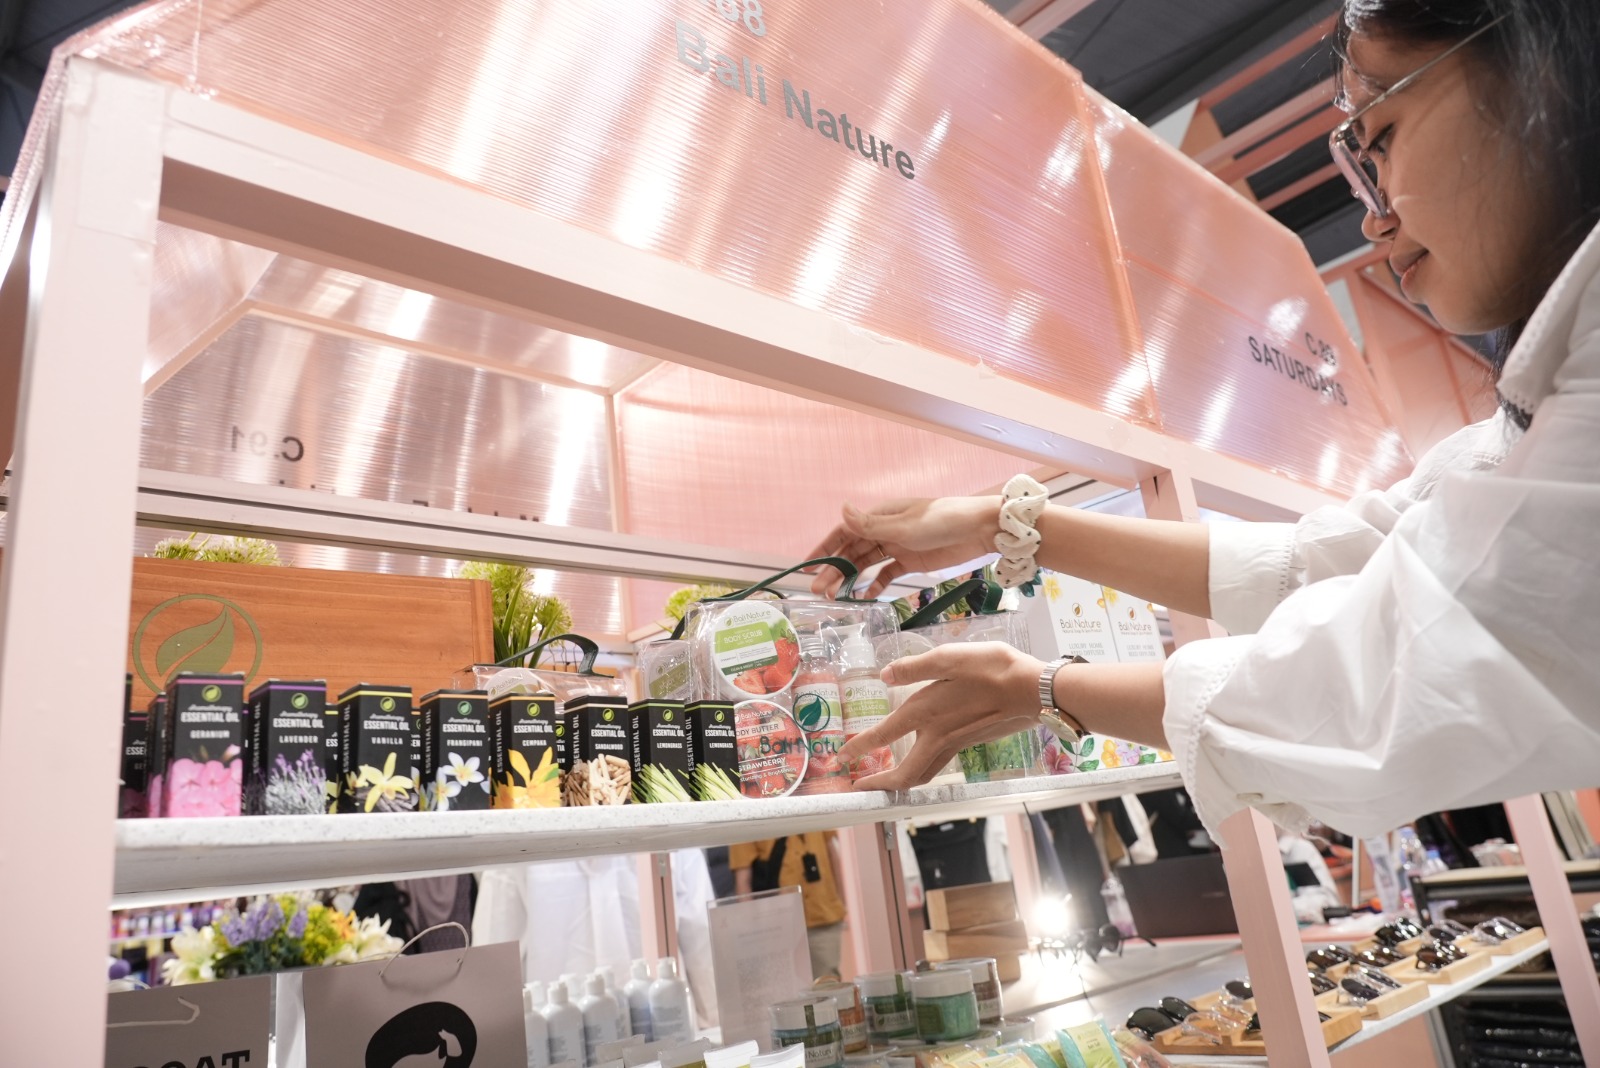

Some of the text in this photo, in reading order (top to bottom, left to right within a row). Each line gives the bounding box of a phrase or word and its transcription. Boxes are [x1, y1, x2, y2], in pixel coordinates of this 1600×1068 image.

[675, 17, 915, 180] Bali Nature
[1248, 335, 1348, 407] SATURDAYS
[1060, 619, 1101, 628] Bali Nature
[1118, 621, 1151, 631] Bali Nature
[724, 633, 741, 644] BODY
[742, 630, 763, 640] SCRUB
[180, 712, 240, 722] ESSENTIAL OIL
[273, 718, 324, 728] ESSENTIAL OIL
[363, 720, 410, 731] ESSENTIAL OIL
[442, 724, 486, 733] ESSENTIAL OIL
[513, 725, 554, 733] ESSENTIAL OIL
[591, 729, 626, 738] ESSENTIAL OIL
[652, 729, 685, 737] ESSENTIAL OIL
[736, 724, 779, 737] ODY BUTTER
[190, 730, 230, 738] GERANIUM
[279, 735, 318, 743] LAVENDER
[760, 735, 793, 754] Bali
[738, 757, 786, 772] STRAWBERRY
